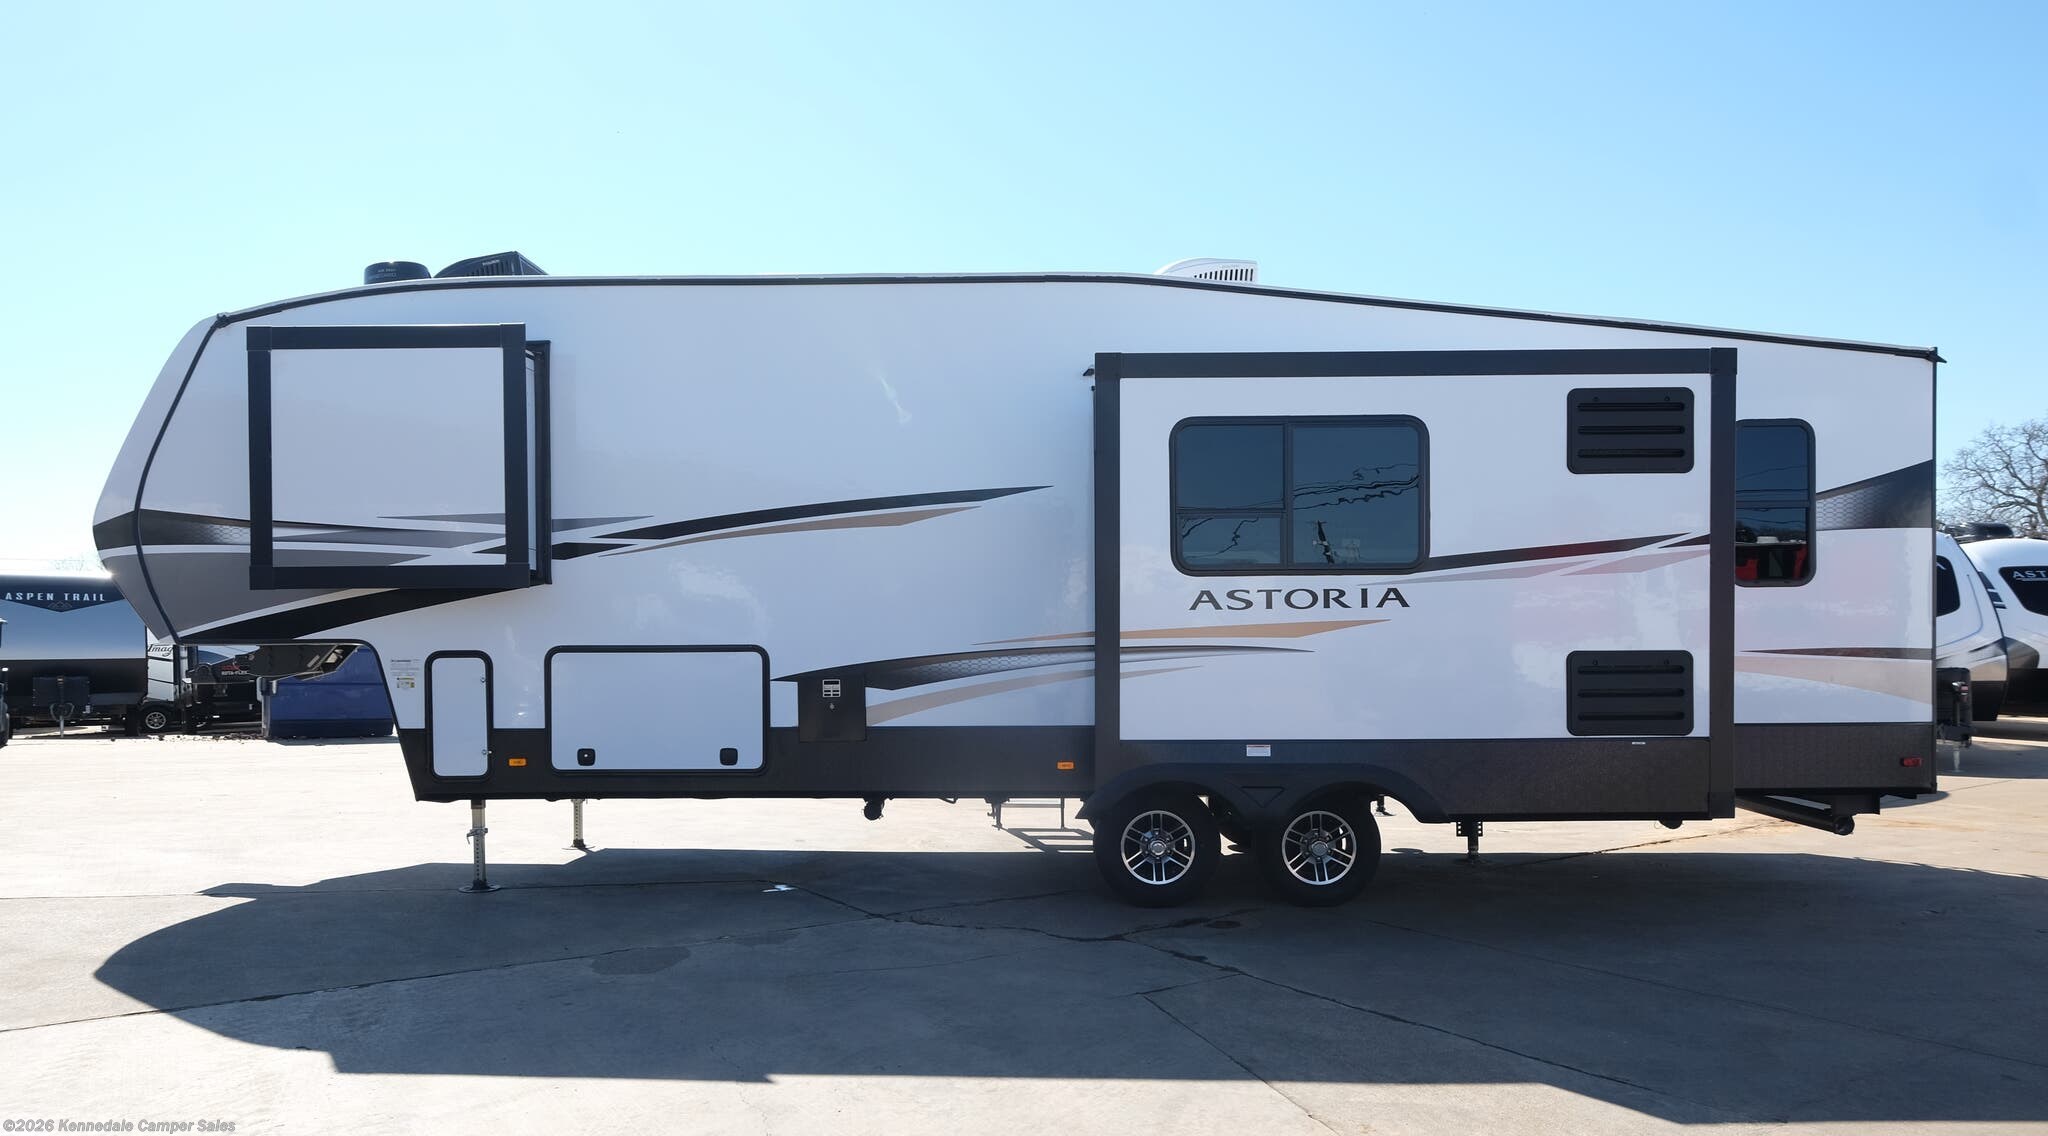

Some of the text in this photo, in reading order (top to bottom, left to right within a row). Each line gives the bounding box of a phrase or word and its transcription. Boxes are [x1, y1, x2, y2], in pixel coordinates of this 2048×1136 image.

[2013, 570, 2048, 578] AST
[5, 592, 105, 601] ASPEN TRAIL
[1189, 587, 1410, 610] ASTORIA
[148, 643, 173, 657] Imag
